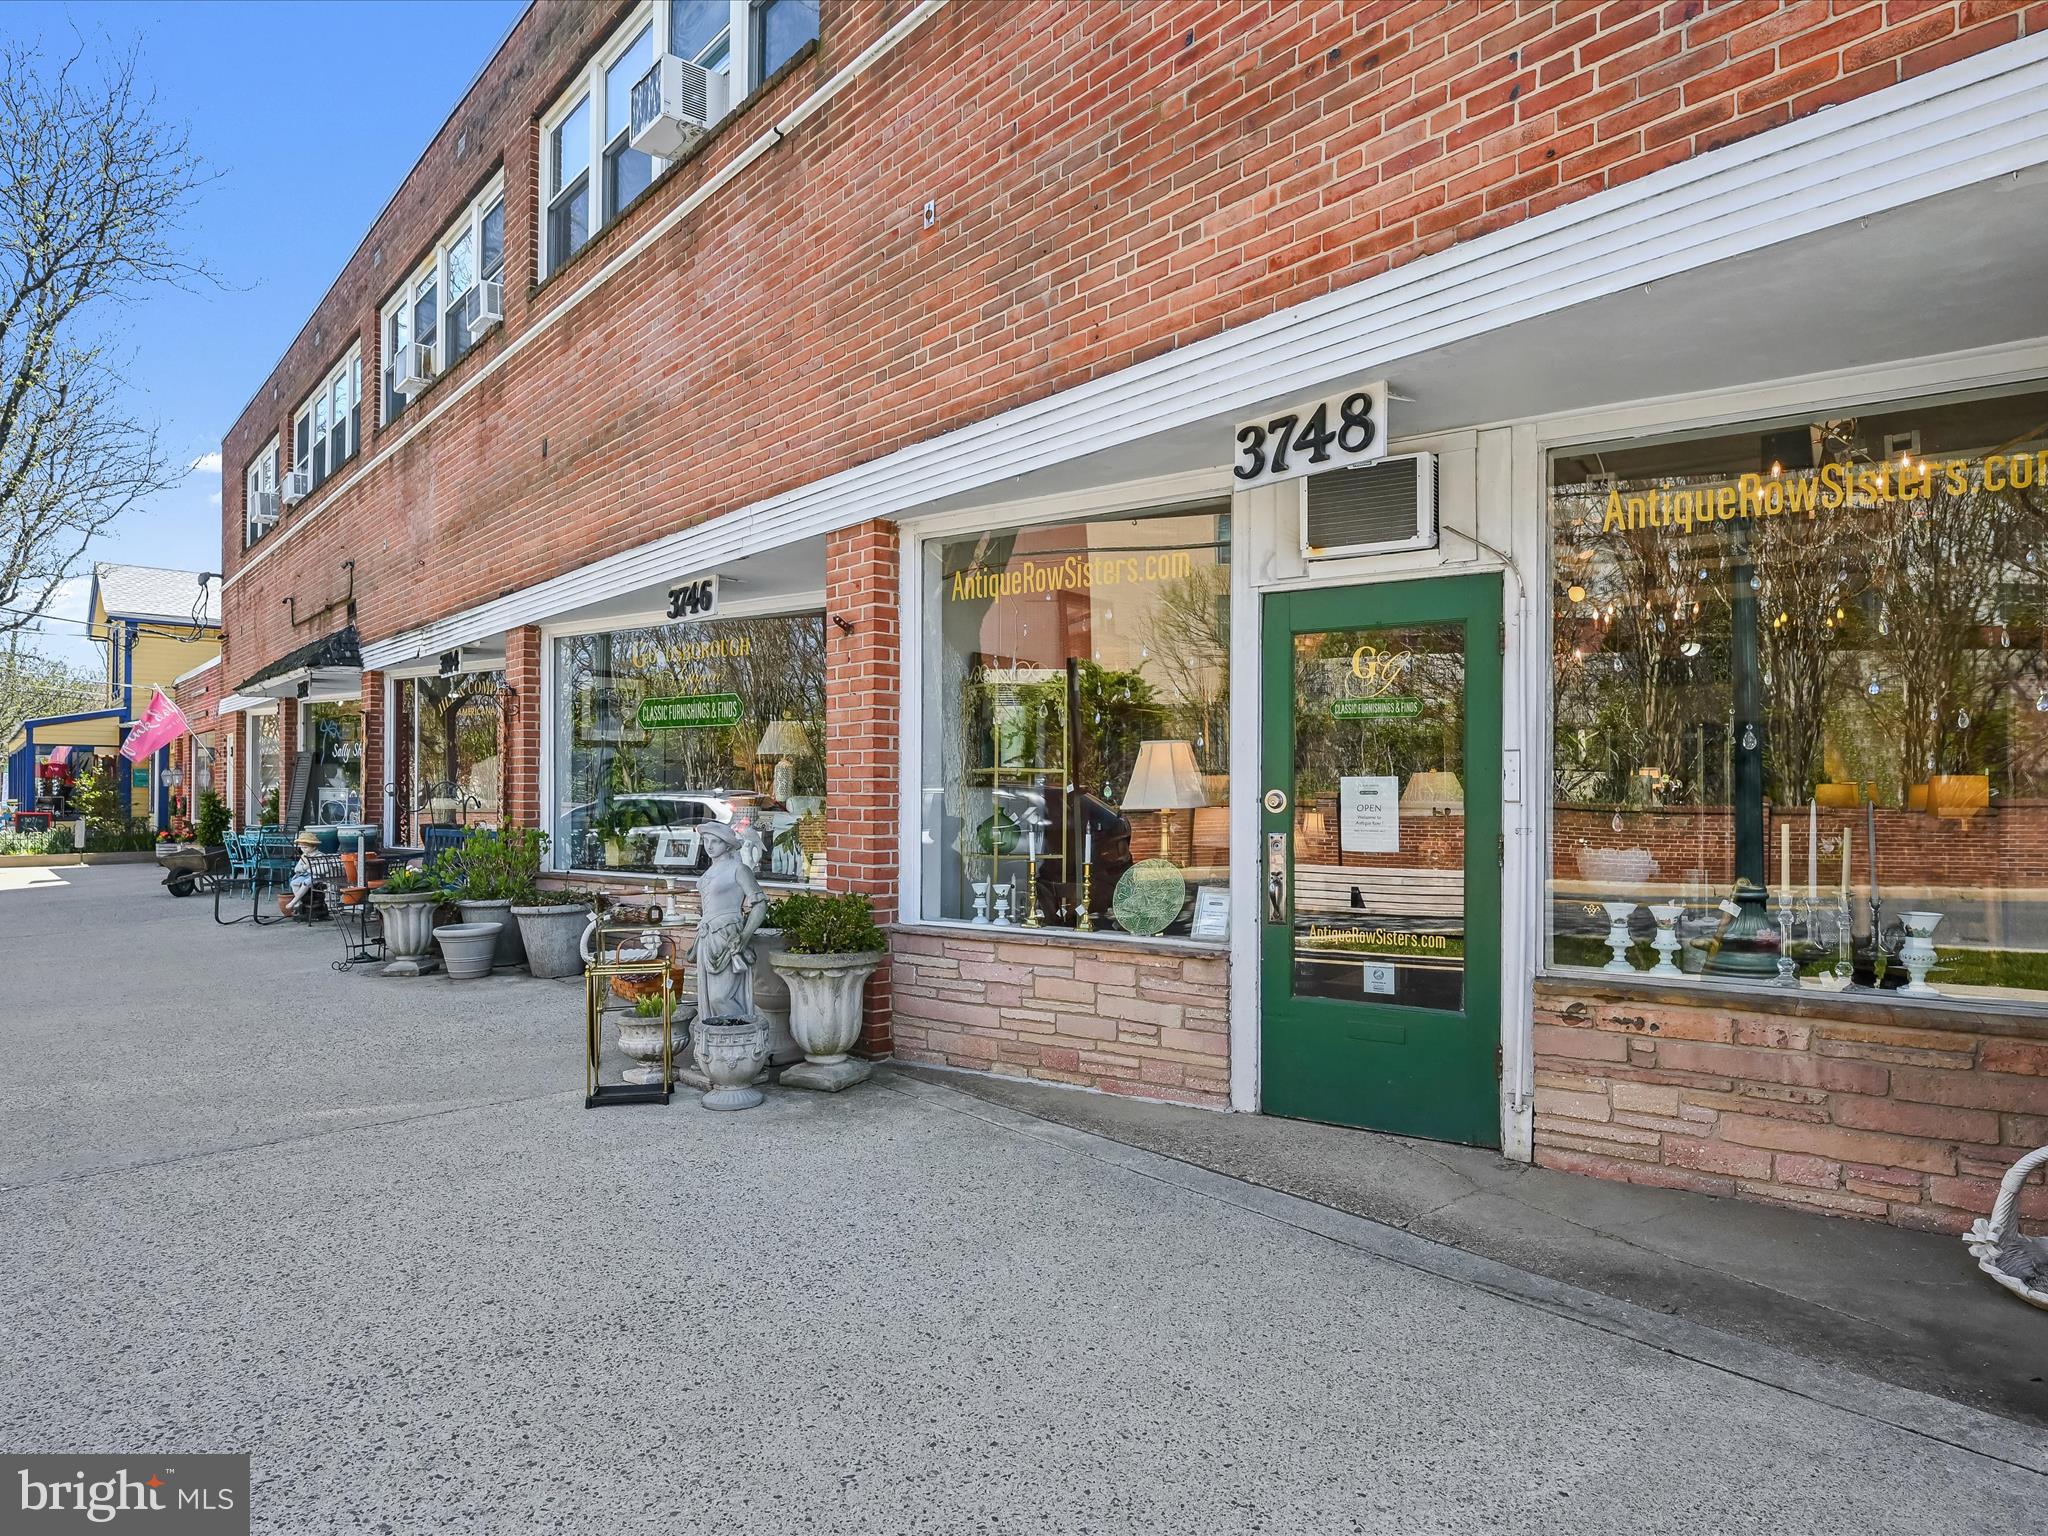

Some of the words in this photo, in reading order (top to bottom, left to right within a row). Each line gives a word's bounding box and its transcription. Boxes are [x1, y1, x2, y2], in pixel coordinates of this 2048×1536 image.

[1233, 392, 1376, 480] 3748
[951, 551, 1191, 604] AntiqueRowSisters.com
[666, 579, 713, 619] 3746
[631, 637, 751, 669] GODSBOROUGH
[642, 705, 668, 722] CLASSIC
[669, 703, 711, 721] FURNISHINGS
[711, 702, 718, 719] &
[717, 701, 738, 718] FINDS
[1334, 703, 1357, 714] CLASSIC
[1358, 702, 1395, 714] FURNISHINGS
[332, 743, 351, 763] Sally
[1356, 804, 1382, 813] OPEN
[1309, 922, 1446, 949] AntiqueRowSisters.com
